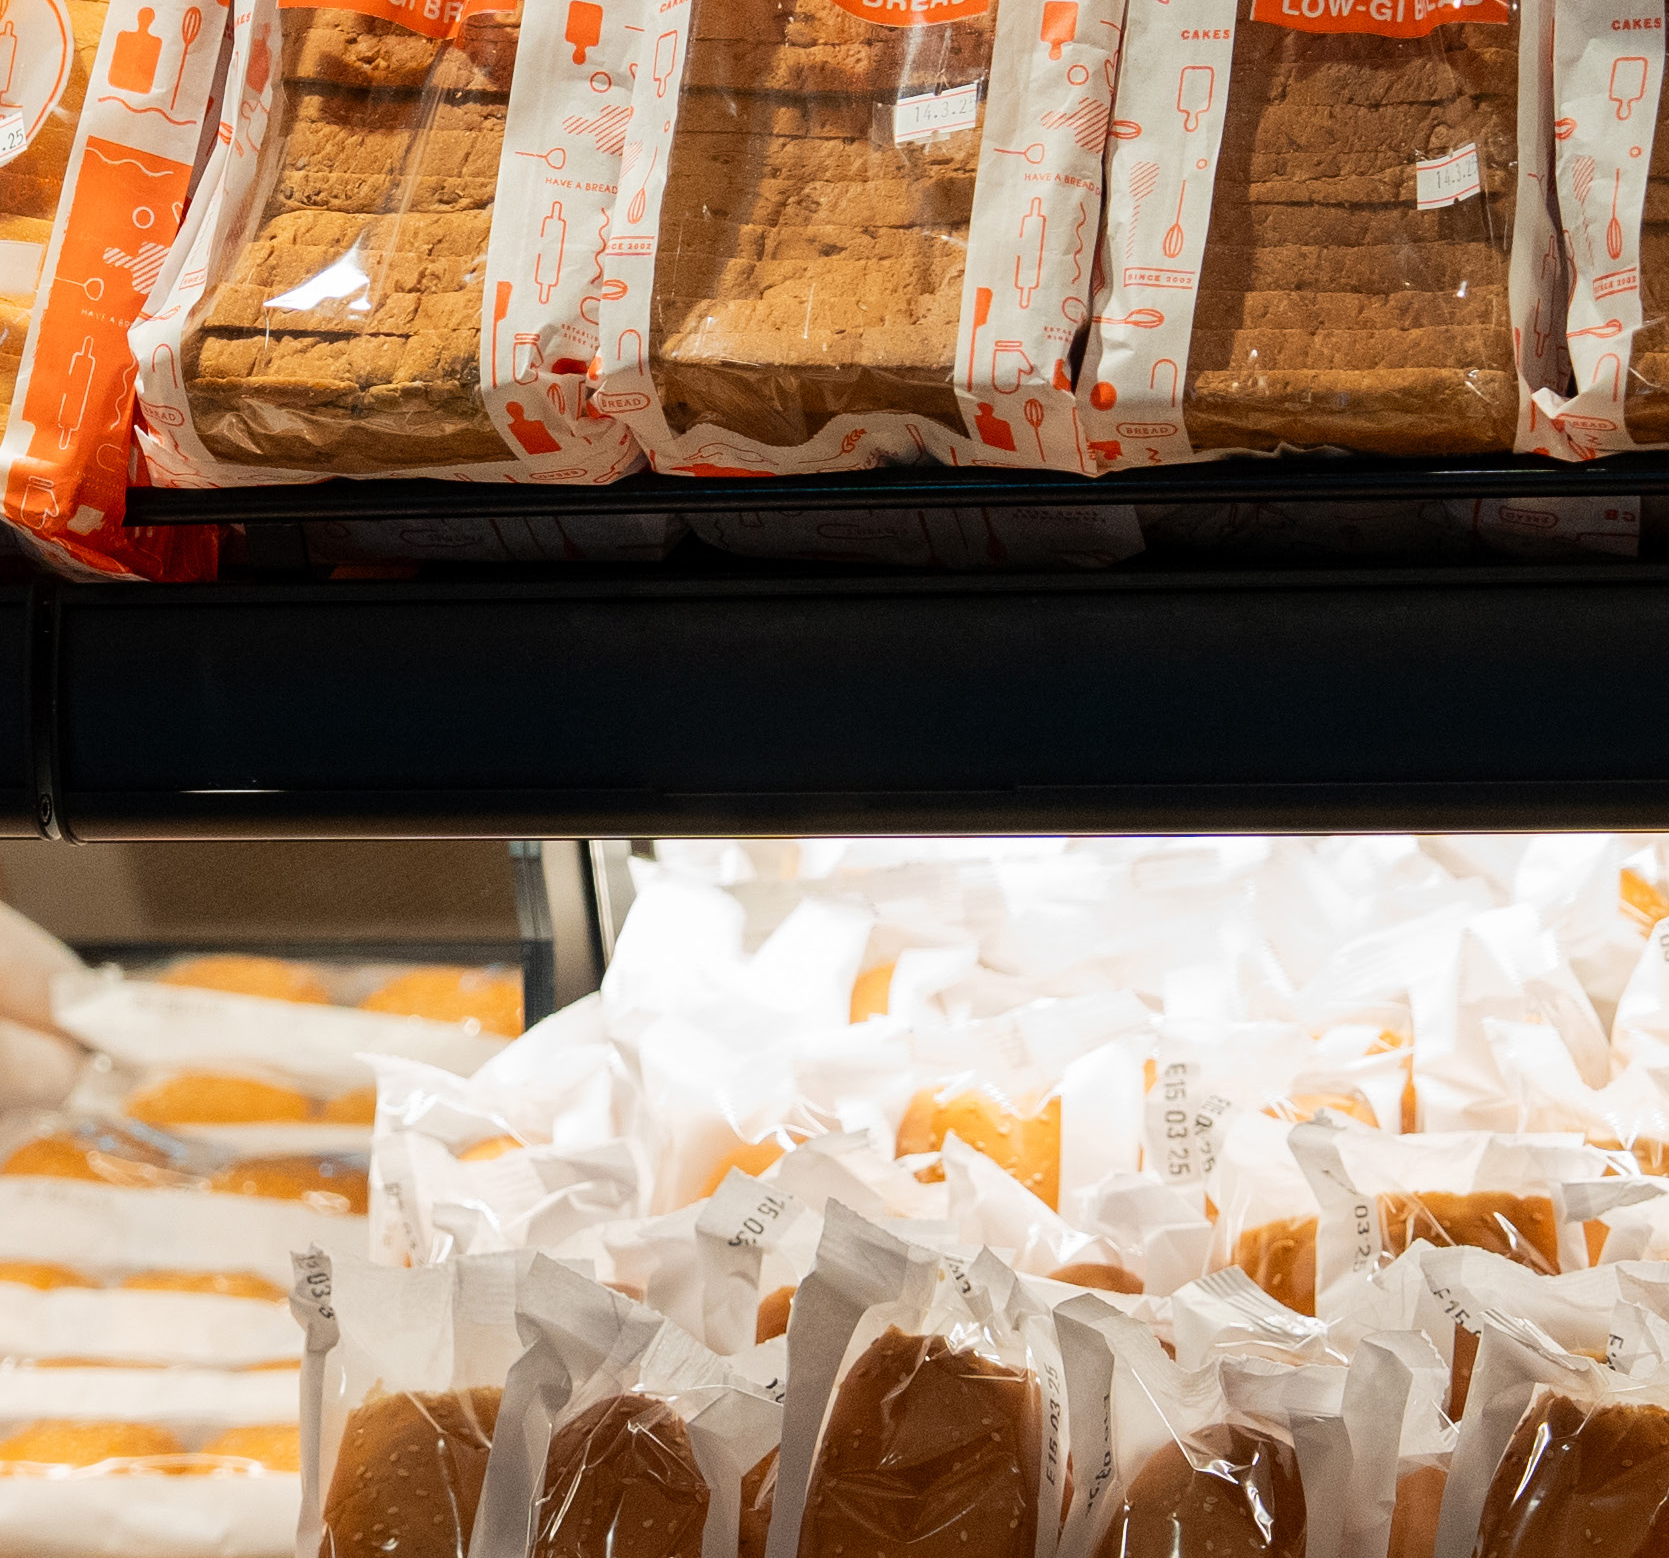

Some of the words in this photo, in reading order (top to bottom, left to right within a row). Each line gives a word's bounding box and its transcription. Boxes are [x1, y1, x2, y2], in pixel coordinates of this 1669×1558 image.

[1611, 17, 1662, 31] CAKES
[1180, 29, 1231, 41] CAKES
[914, 93, 977, 124] 14.3.25
[545, 176, 572, 190] HAVE
[575, 181, 583, 191] A
[585, 182, 618, 195] BREAD
[1024, 172, 1052, 182] HAVE
[1054, 173, 1062, 182] A
[1064, 174, 1094, 193] BREAD
